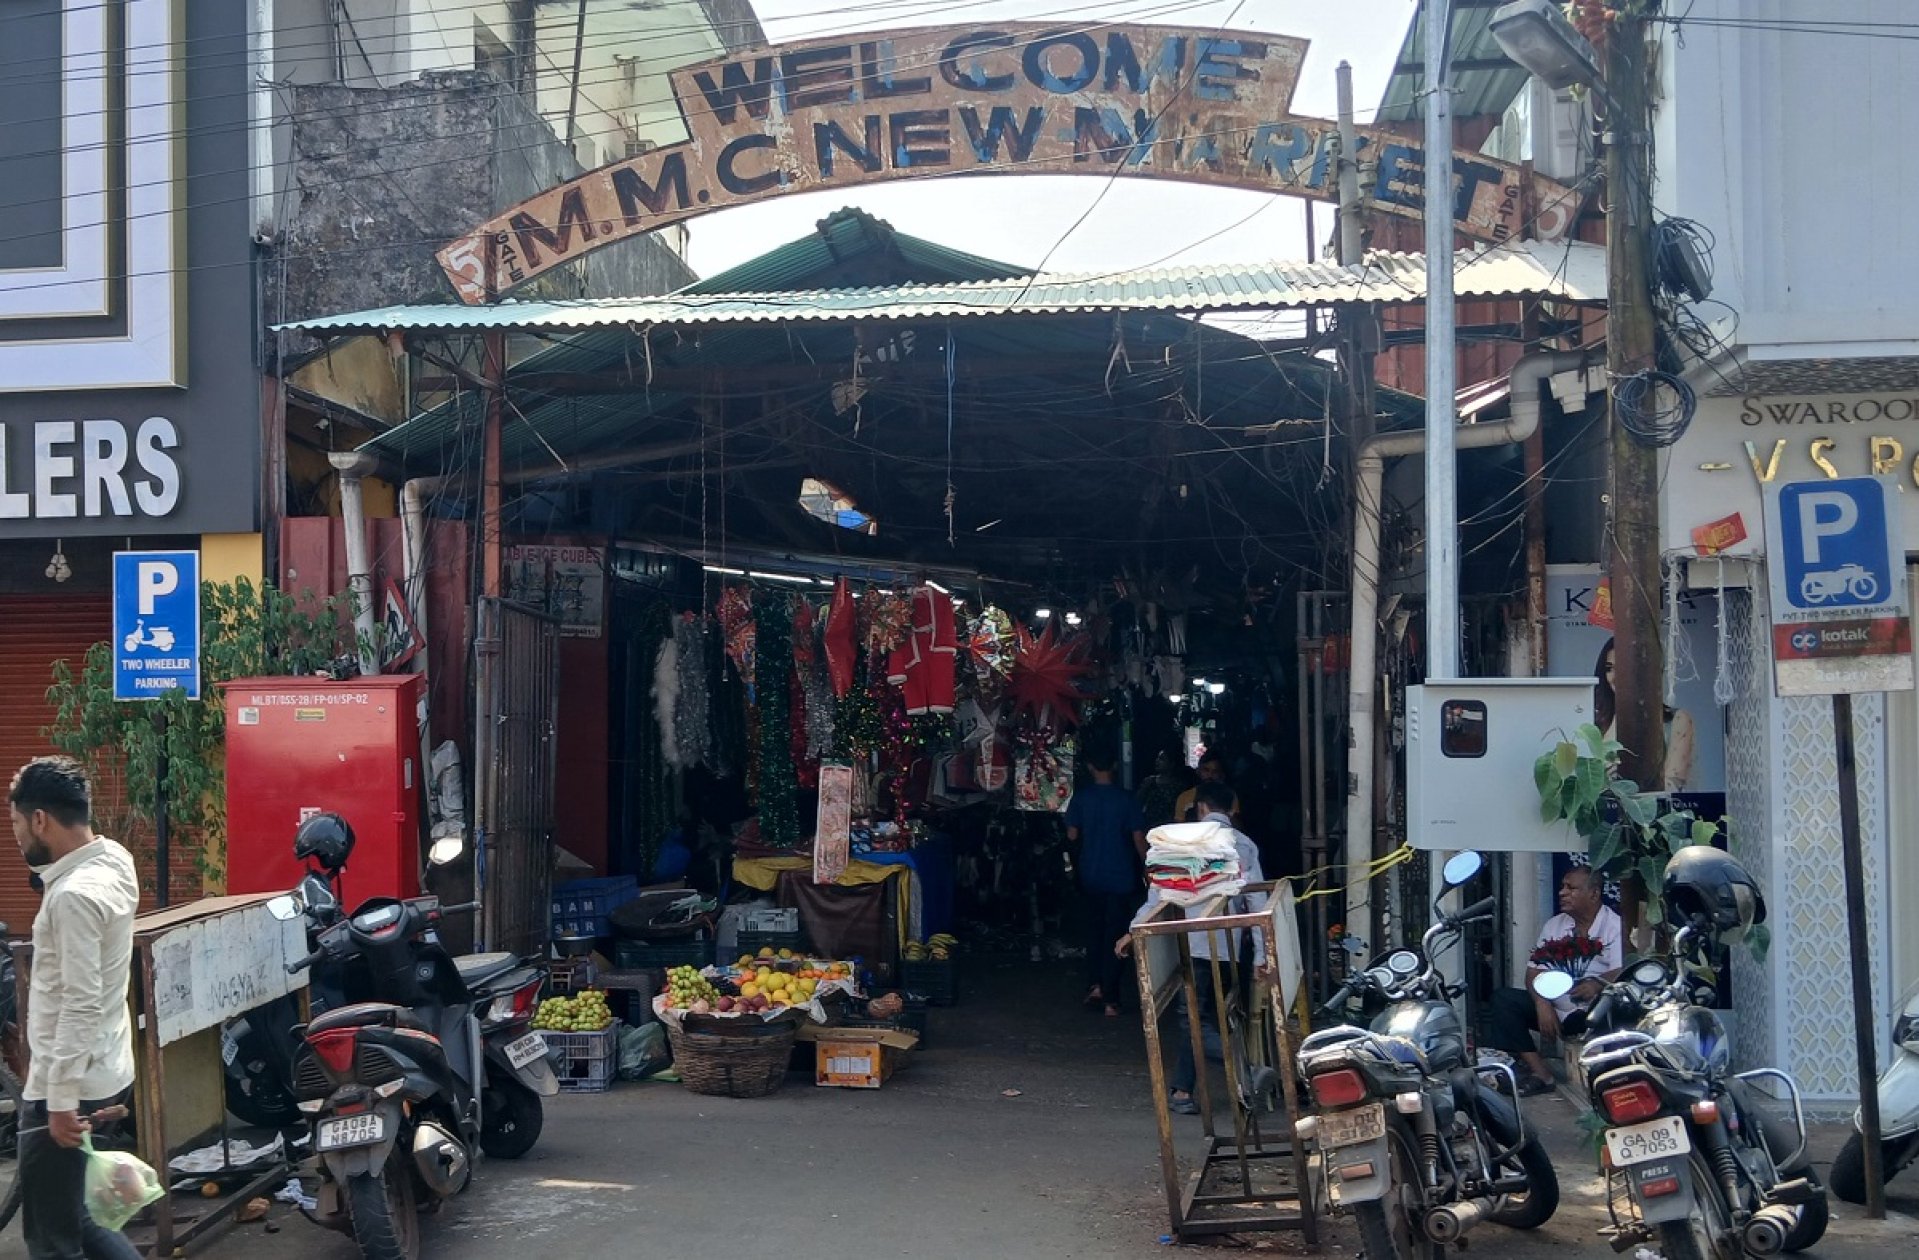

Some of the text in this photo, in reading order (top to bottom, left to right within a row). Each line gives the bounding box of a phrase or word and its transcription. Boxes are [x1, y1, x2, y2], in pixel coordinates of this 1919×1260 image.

[693, 31, 1267, 126] WELCOME
[813, 105, 1043, 177] NEW
[1492, 185, 1520, 240] GATE
[448, 237, 486, 292] 5
[494, 230, 525, 282] GATE
[1740, 396, 1919, 426] SWAROO
[0, 416, 181, 519] LERS
[1798, 491, 1859, 564] P
[561, 548, 600, 563] CUBES
[138, 561, 179, 615] P
[1863, 605, 1901, 615] PARKING
[1820, 628, 1868, 642] kotak
[121, 658, 191, 671] TWO WHEELER
[135, 677, 177, 689] PARKING
